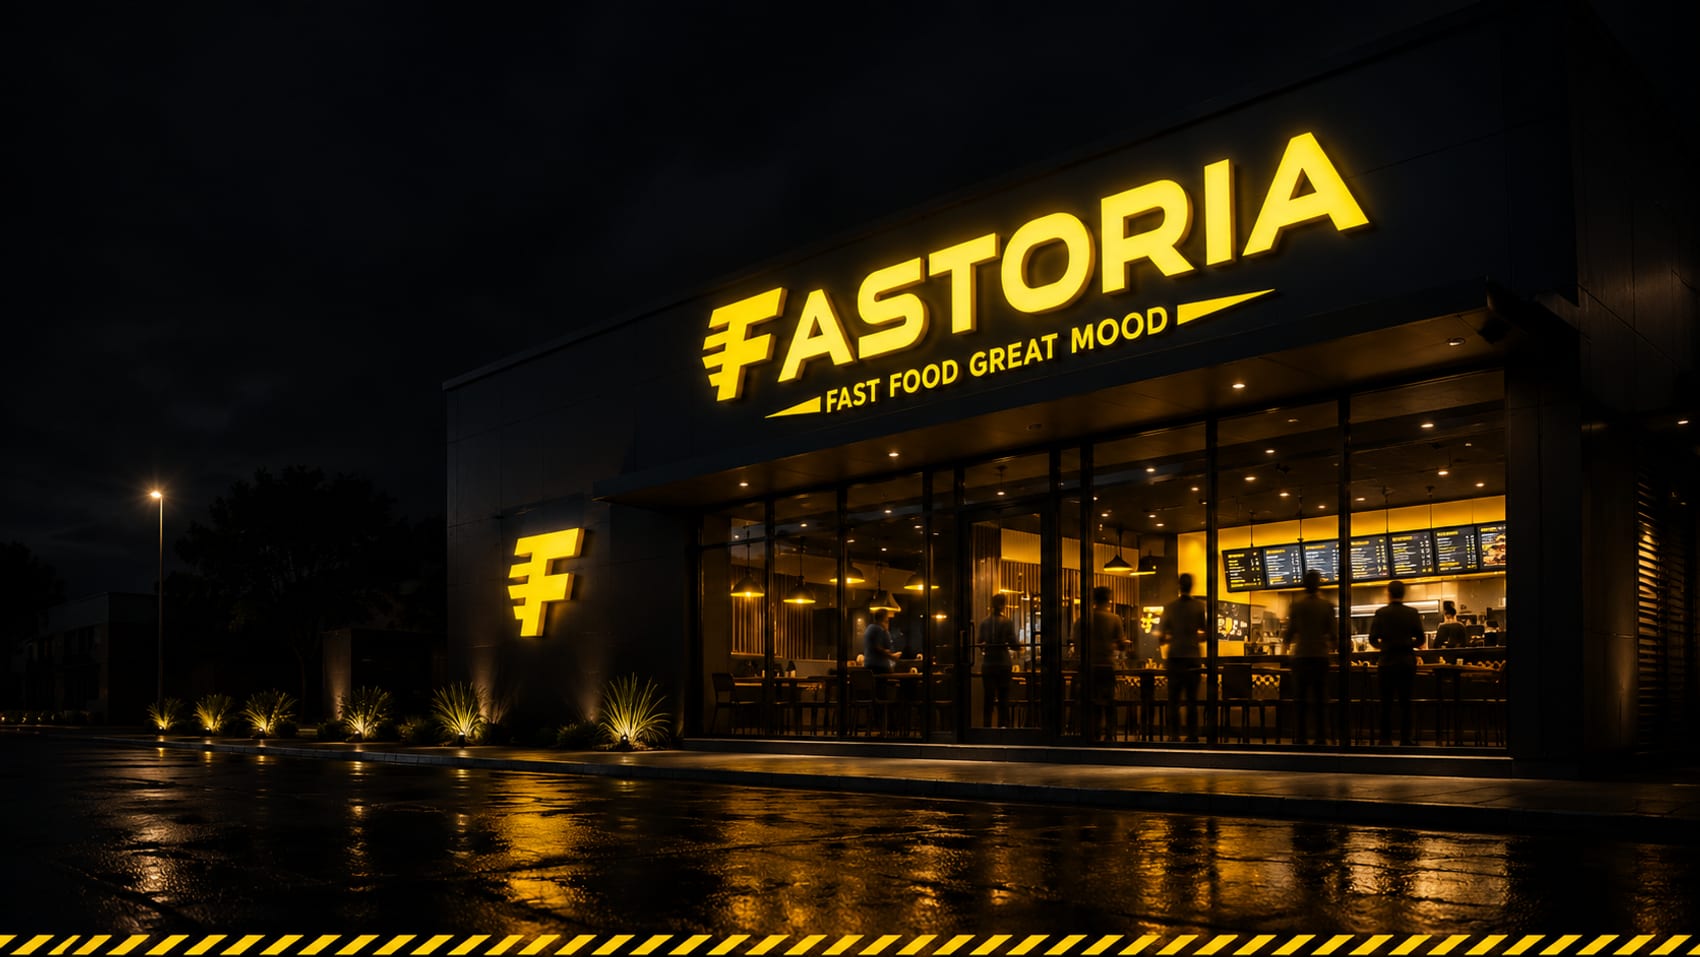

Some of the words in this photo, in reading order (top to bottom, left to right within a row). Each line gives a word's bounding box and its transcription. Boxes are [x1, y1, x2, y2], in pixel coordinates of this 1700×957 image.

[701, 131, 1371, 403] FASTORIA
[825, 378, 881, 413] FAST
[889, 359, 960, 398] FOOD
[969, 332, 1059, 377] GREAT
[1070, 306, 1169, 354] MOOD
